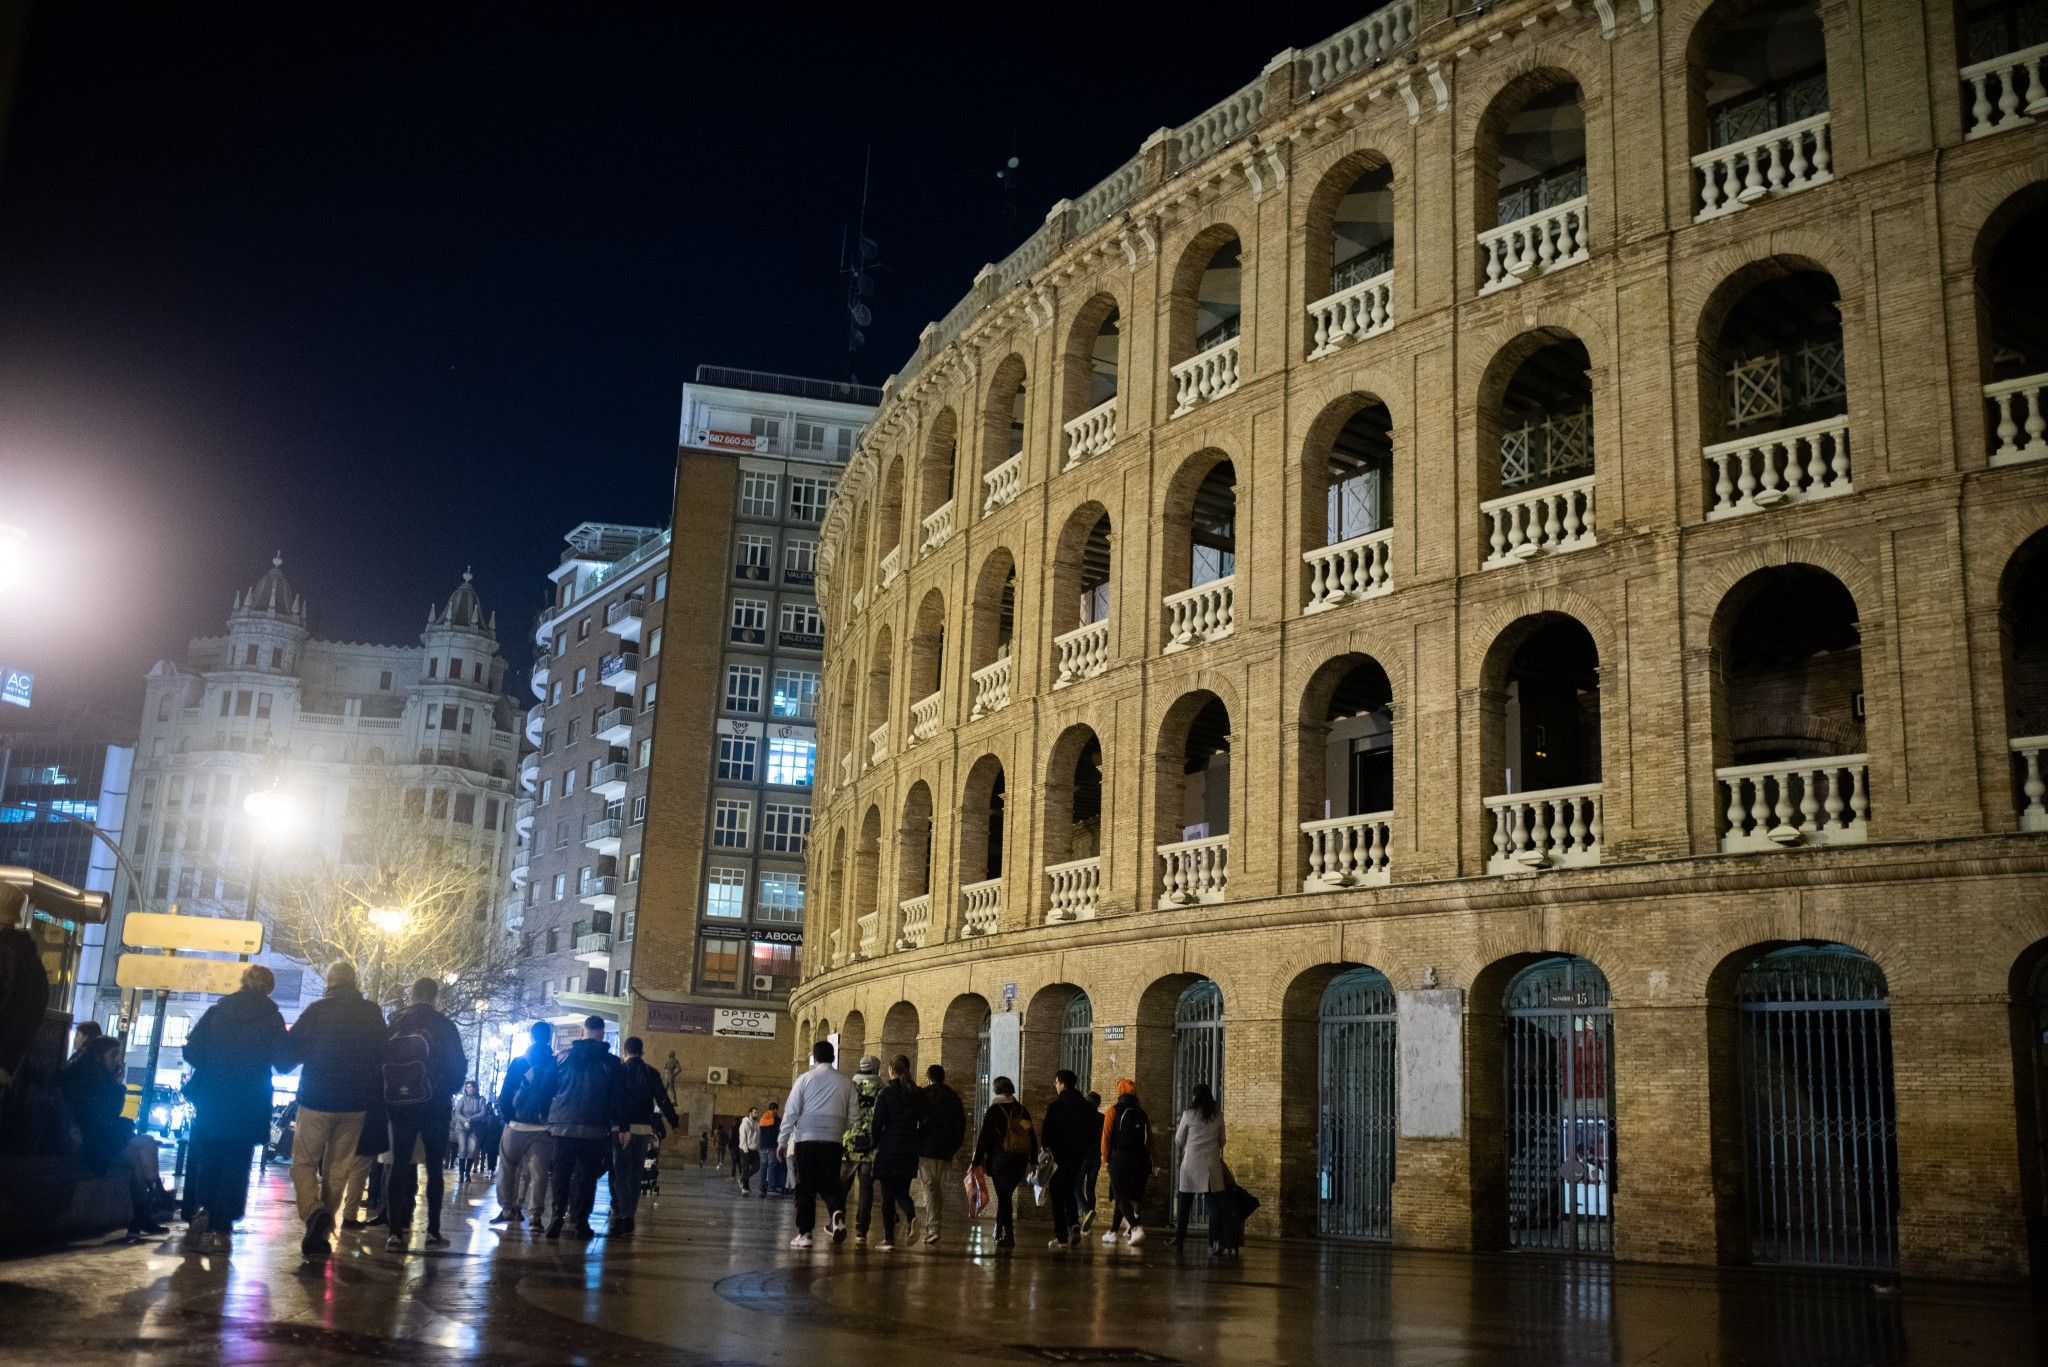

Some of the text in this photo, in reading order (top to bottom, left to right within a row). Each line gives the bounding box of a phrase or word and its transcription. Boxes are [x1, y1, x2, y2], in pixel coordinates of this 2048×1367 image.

[8, 672, 30, 689] AC
[1577, 993, 1587, 1005] 15
[721, 1010, 770, 1020] OPTICA
